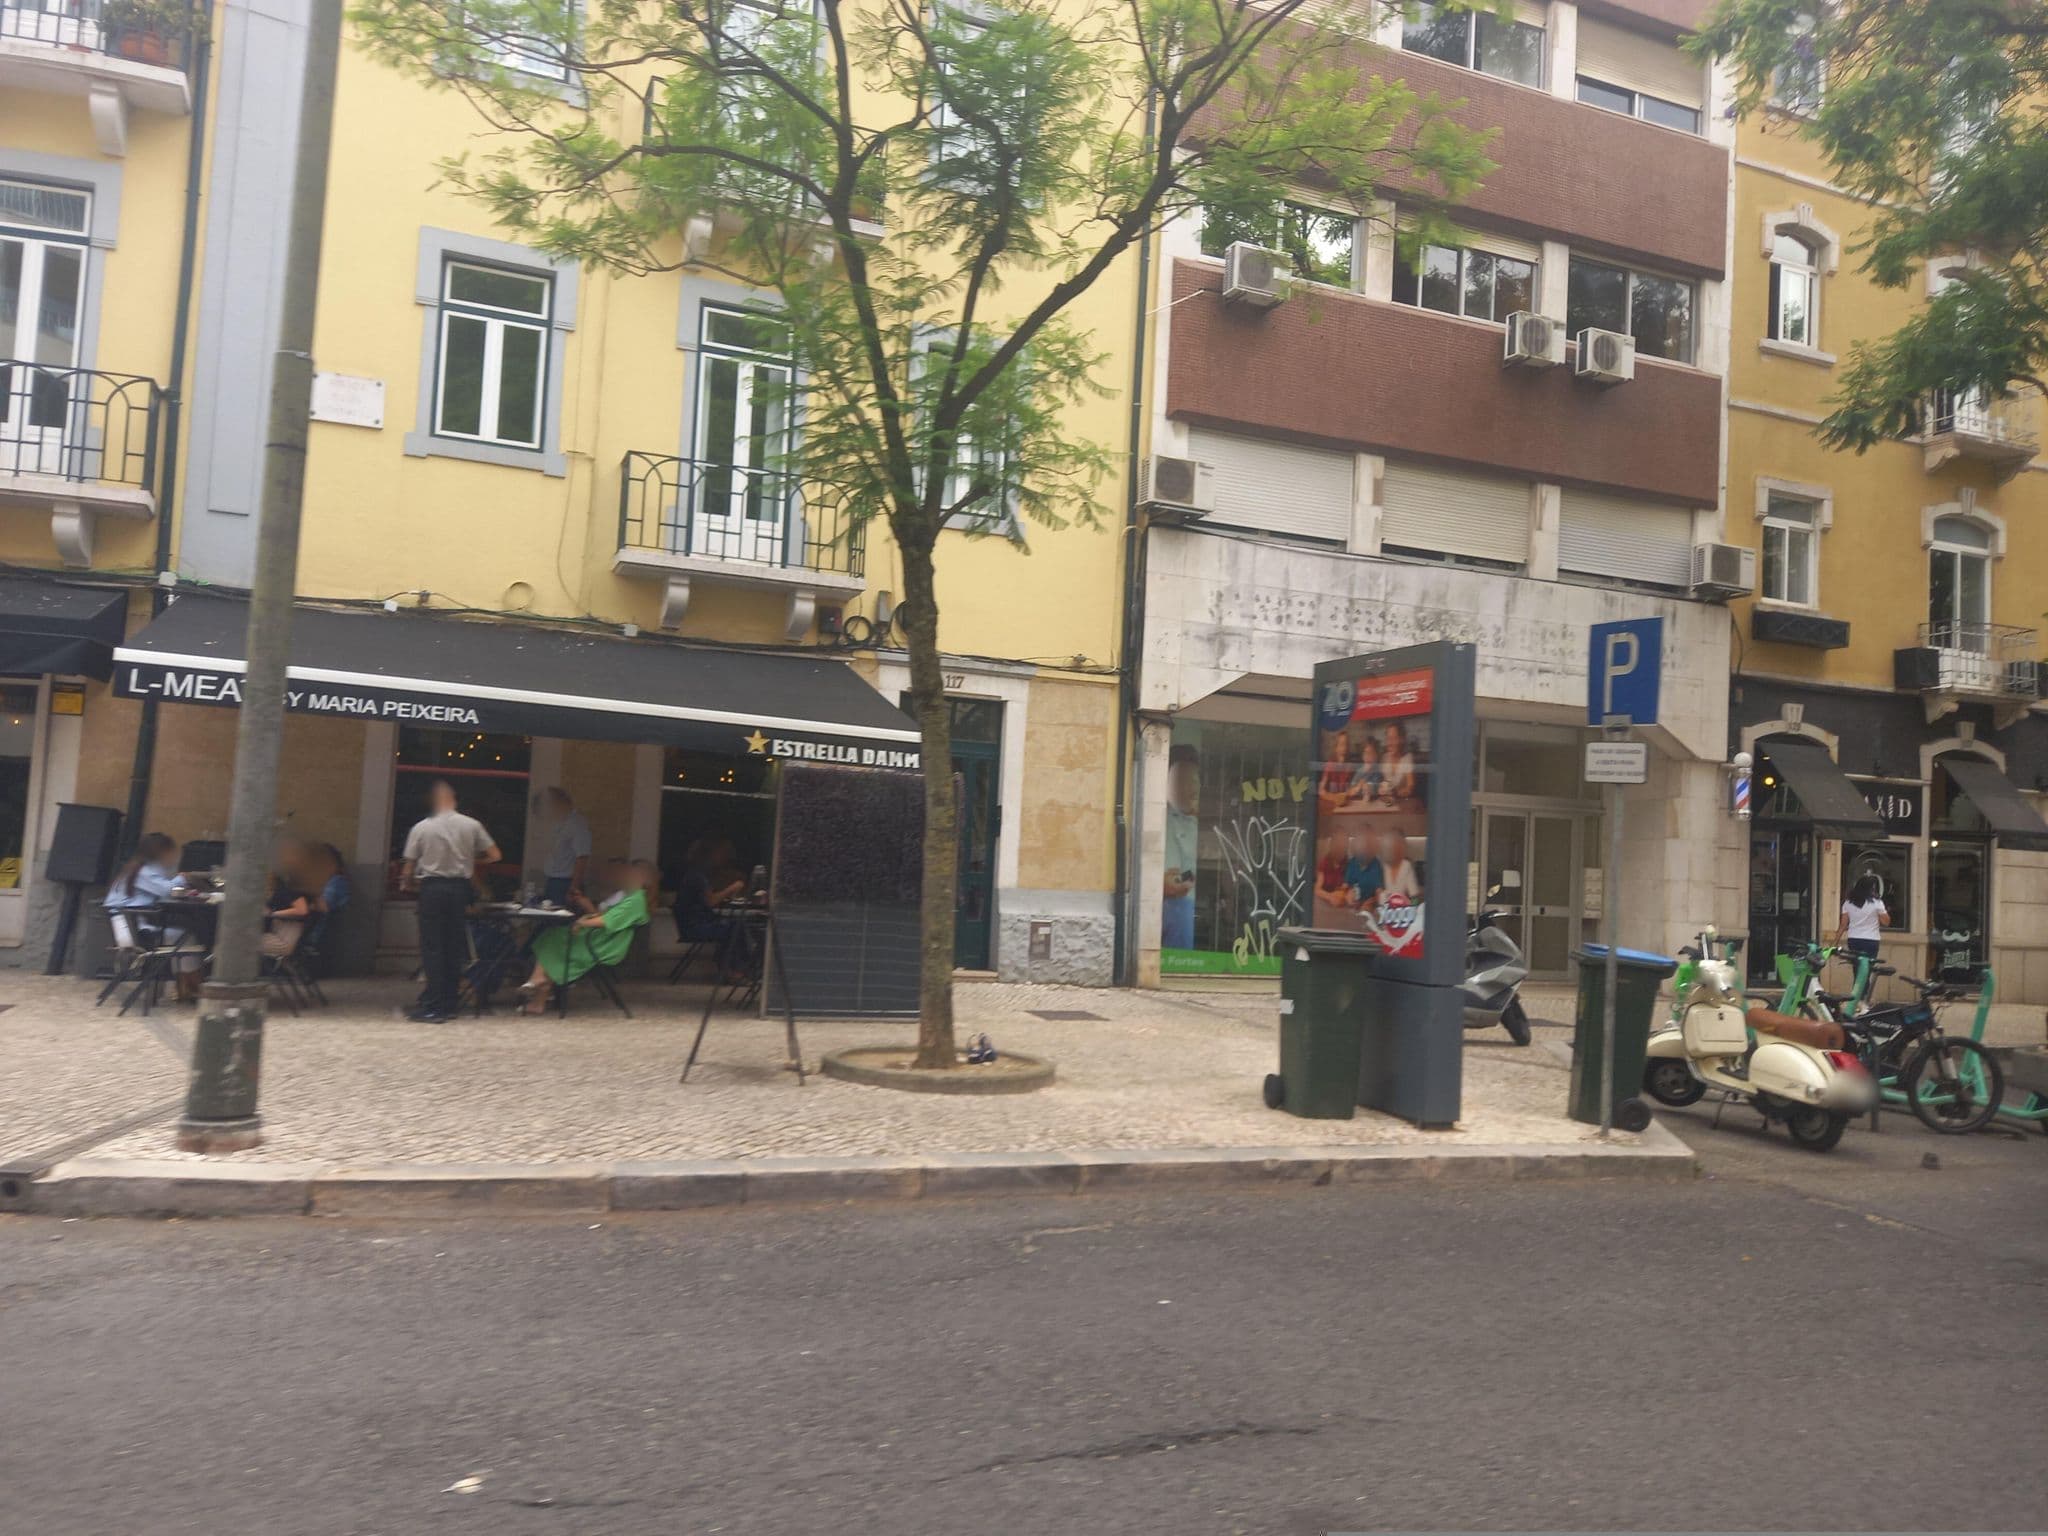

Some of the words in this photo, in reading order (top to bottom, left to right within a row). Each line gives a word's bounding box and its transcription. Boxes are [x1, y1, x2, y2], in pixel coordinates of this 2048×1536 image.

[945, 675, 964, 689] 117
[1603, 632, 1640, 713] P
[128, 668, 247, 702] L-MEA
[307, 693, 378, 715] MARIA
[382, 701, 480, 724] PEIXEIRA
[772, 739, 858, 763] ESTRELLA
[862, 748, 920, 769] DAMM
